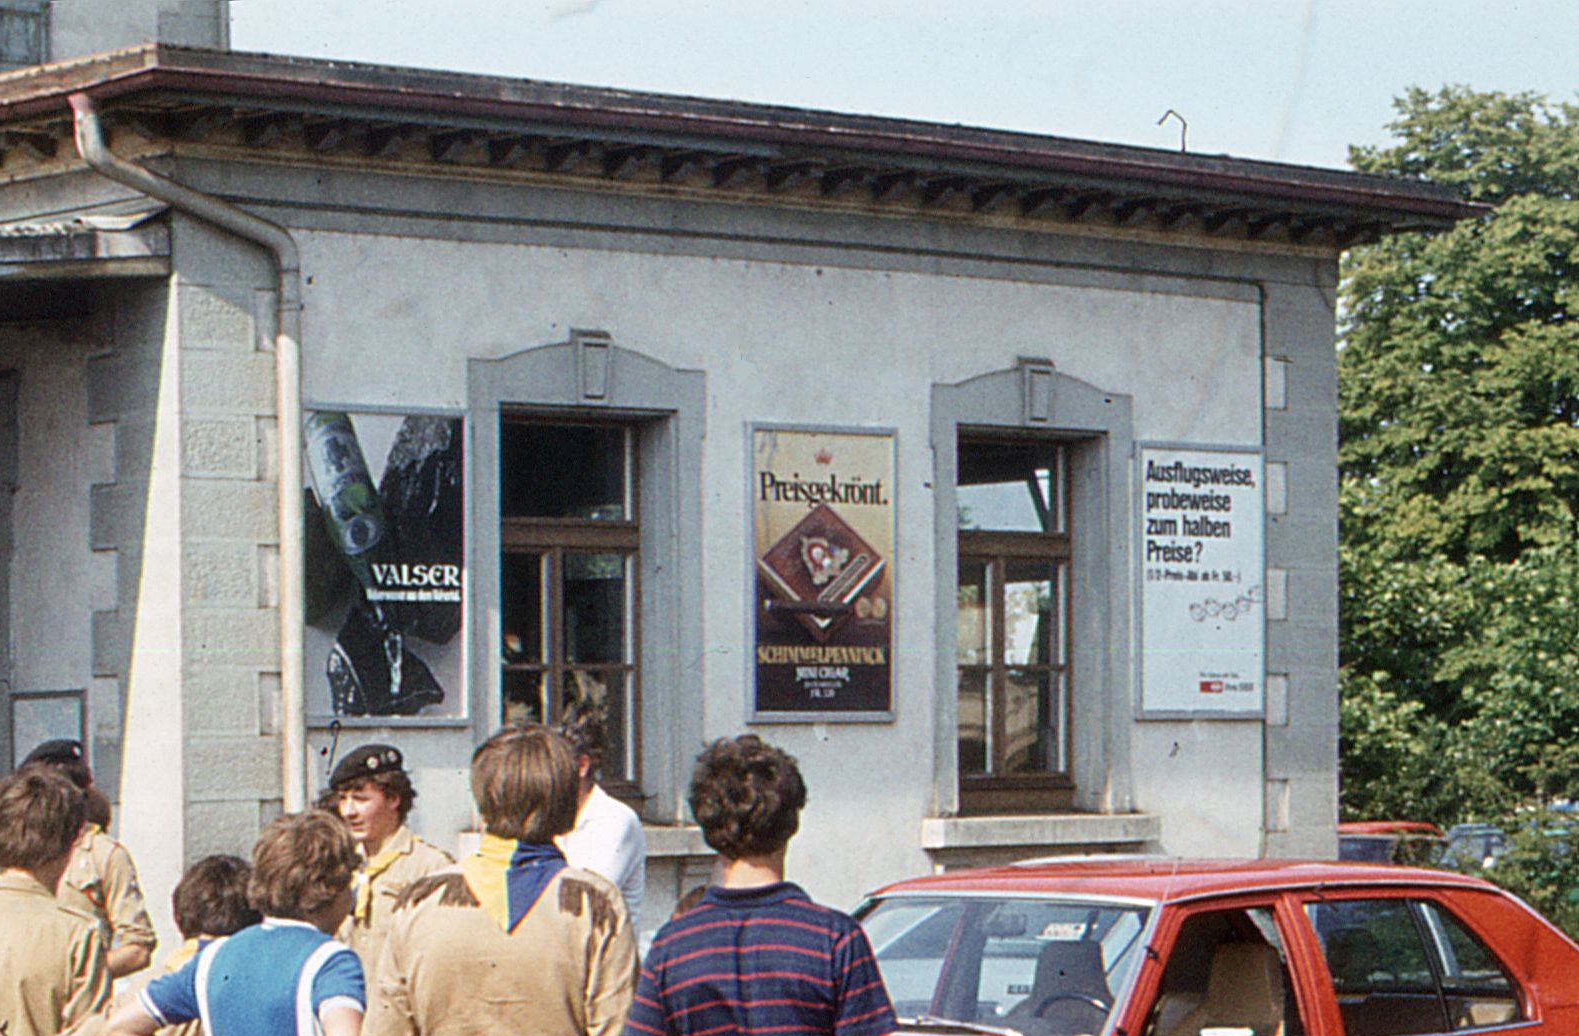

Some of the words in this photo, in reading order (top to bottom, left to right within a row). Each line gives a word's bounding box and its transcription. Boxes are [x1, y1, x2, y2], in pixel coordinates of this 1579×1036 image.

[1147, 460, 1255, 489] Ausflugsweise,
[759, 471, 889, 510] Preisgekrönt.
[1147, 488, 1231, 513] probeweise
[1147, 518, 1177, 536] zum
[1183, 515, 1231, 538] halben
[371, 563, 461, 587] VALSER
